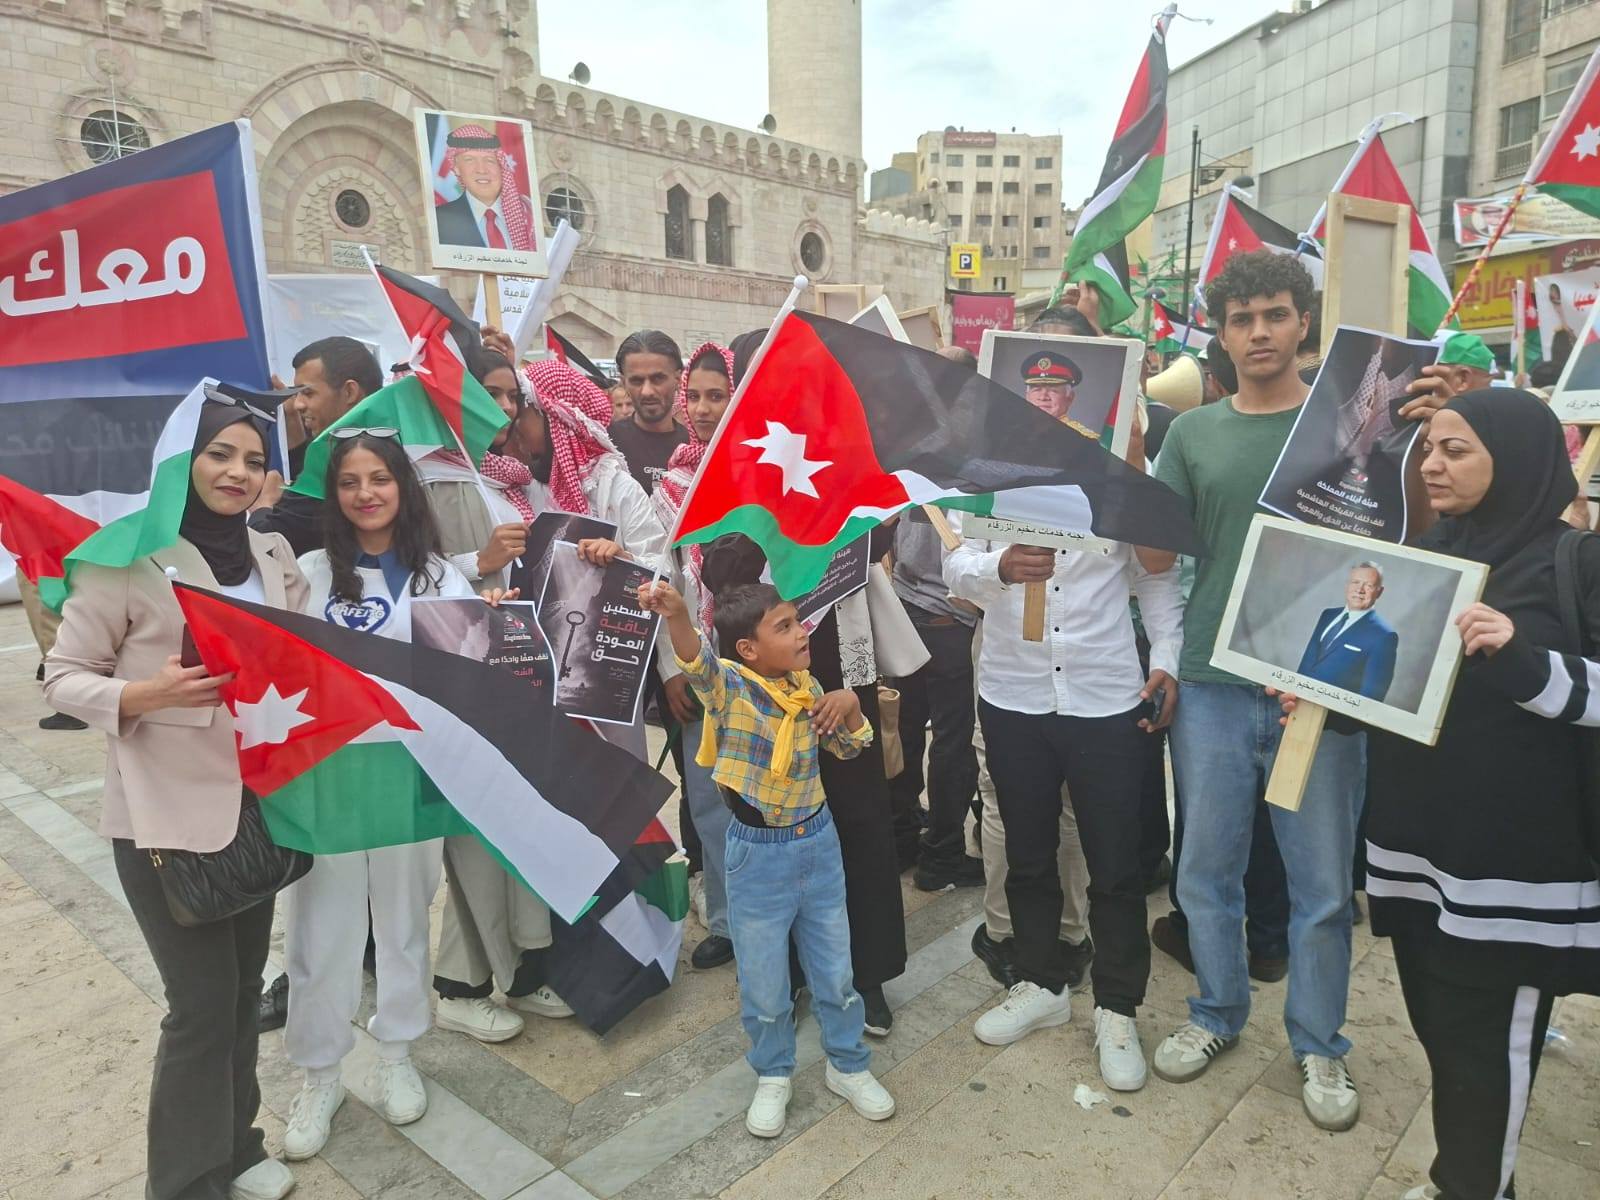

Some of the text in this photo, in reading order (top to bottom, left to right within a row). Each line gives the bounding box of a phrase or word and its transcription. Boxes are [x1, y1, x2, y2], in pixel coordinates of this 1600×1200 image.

[0, 229, 206, 316] معك
[1296, 488, 1330, 508] الهاشمية
[1317, 480, 1346, 499] المملكة
[1296, 502, 1323, 520] والهوية
[987, 520, 1014, 532] الزرقاء
